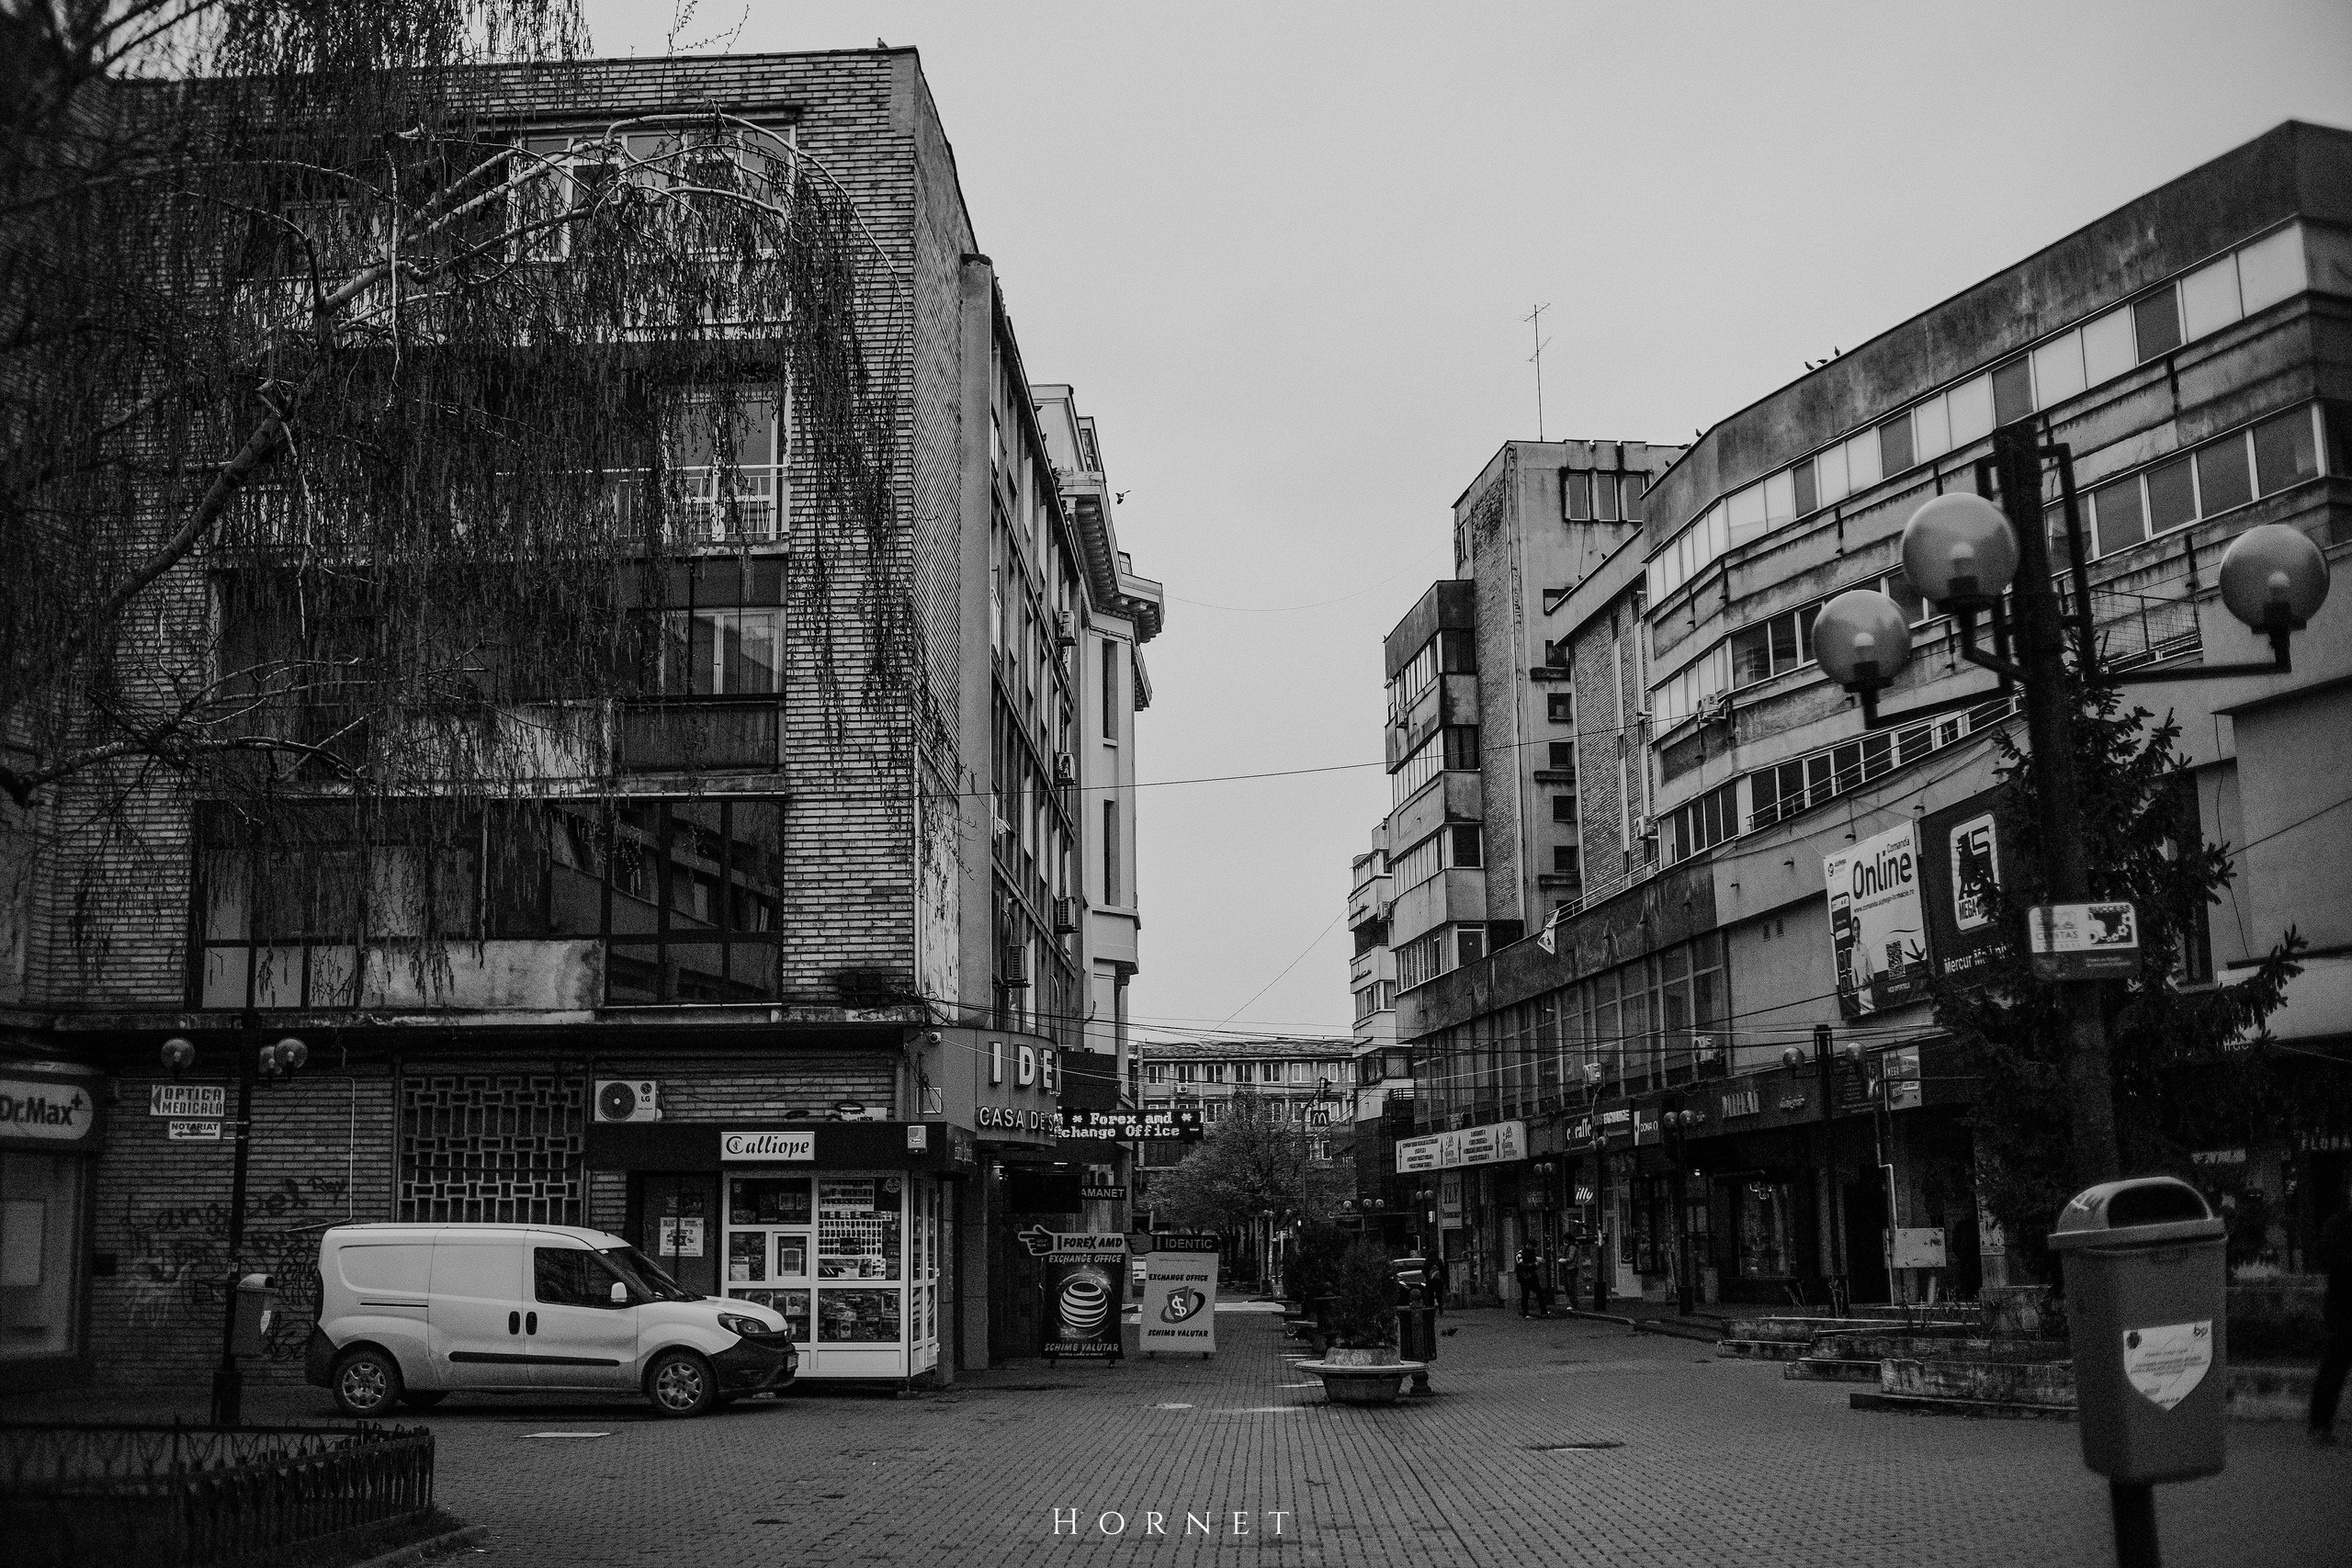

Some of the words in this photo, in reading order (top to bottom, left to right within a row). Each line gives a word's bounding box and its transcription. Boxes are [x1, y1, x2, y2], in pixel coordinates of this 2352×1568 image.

[1853, 852, 1912, 899] Online
[1959, 897, 1978, 921] MEGA
[1944, 953, 1972, 975] Mercur
[164, 1087, 222, 1100] OPTICA
[978, 1106, 1024, 1128] CASA
[1030, 1110, 1046, 1131] DE
[1090, 1112, 1136, 1125] Forex
[171, 1122, 219, 1131] NOTARIAT
[1125, 1124, 1180, 1137] Office
[726, 1134, 809, 1158] Calliope
[1081, 1188, 1125, 1198] AMANET
[1576, 1187, 1594, 1203] illy
[1063, 1235, 1097, 1250] FOREX
[1098, 1236, 1124, 1249] AMD
[1165, 1238, 1213, 1249] IDENTIC
[1048, 1254, 1091, 1264] EXCHANGE
[1094, 1254, 1122, 1263] OFFICE
[1148, 1273, 1184, 1281] EXCHANGE
[1185, 1273, 1208, 1281] OFFICE
[1148, 1328, 1176, 1337] SCHIMB
[1177, 1329, 1209, 1337] VALUTAR
[1044, 1343, 1079, 1352] SCHIMB
[1081, 1342, 1119, 1352] VALUTAR
